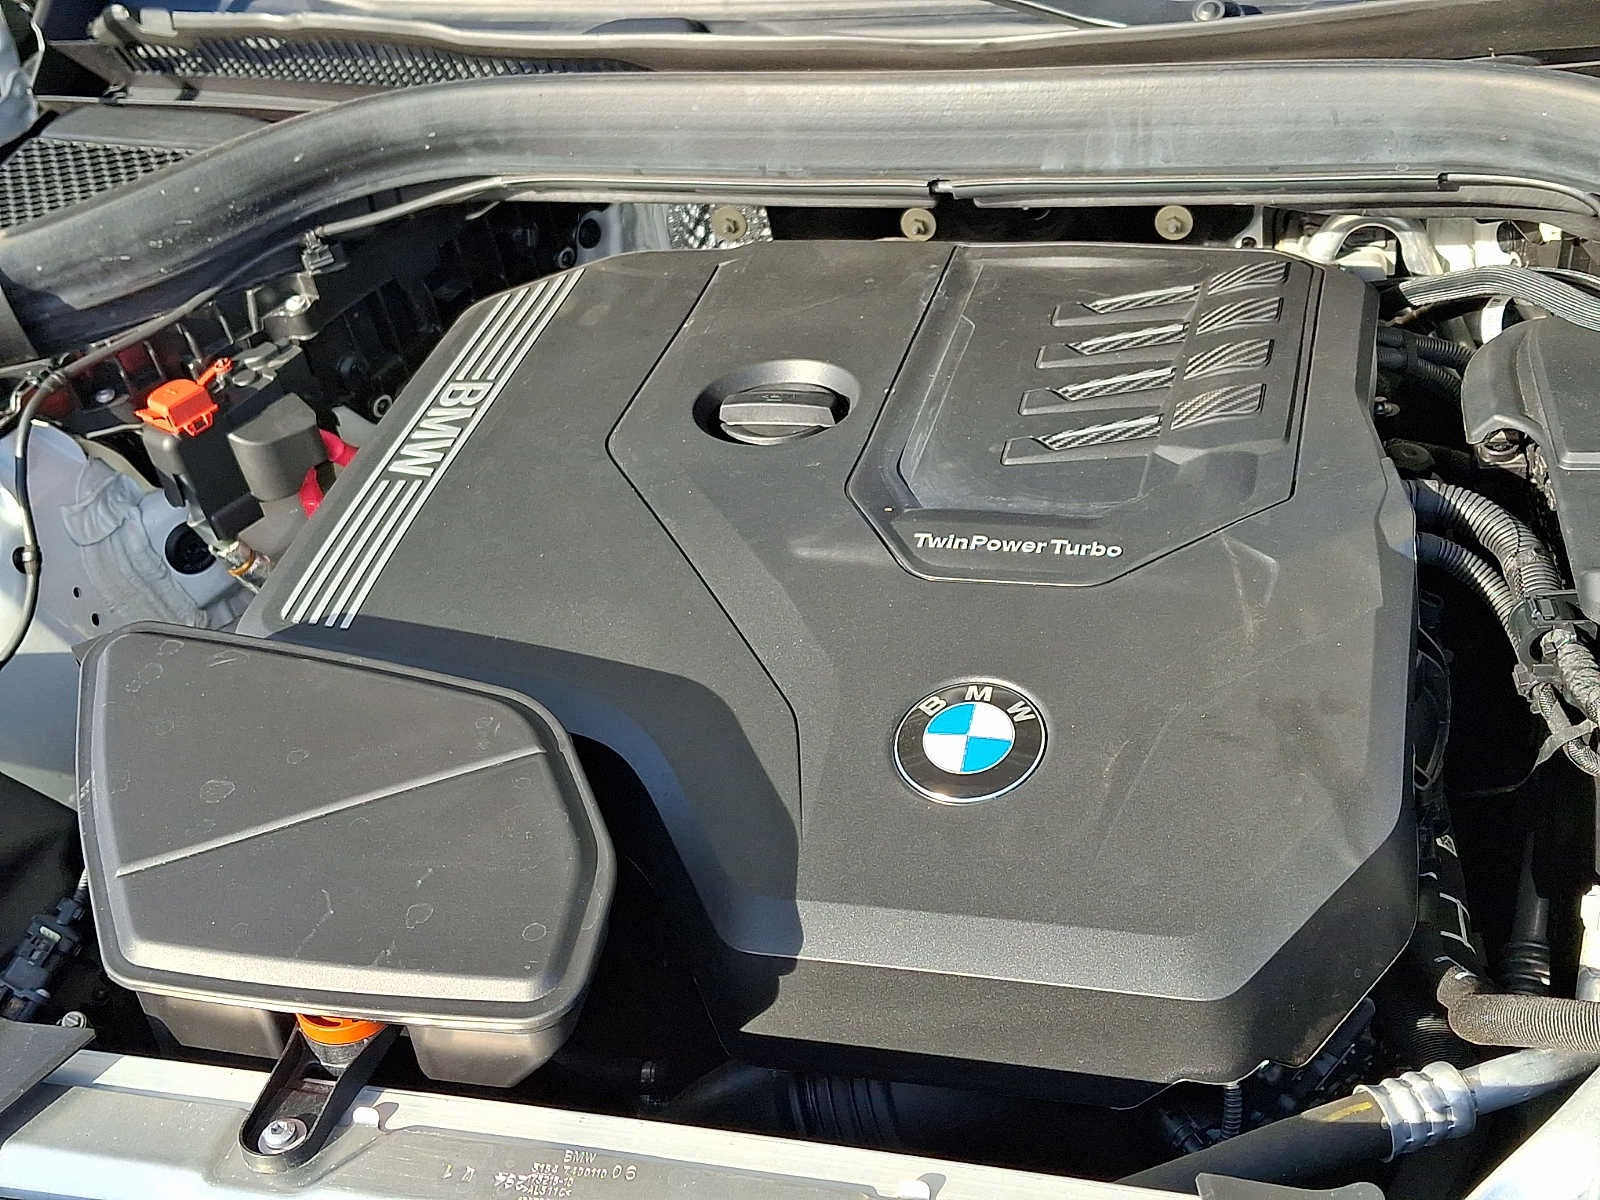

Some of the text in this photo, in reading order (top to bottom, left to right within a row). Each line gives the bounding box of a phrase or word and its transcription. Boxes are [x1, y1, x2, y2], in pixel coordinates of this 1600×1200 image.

[388, 381, 498, 478] BMW
[913, 532, 1123, 557] TwinPower Turbo
[918, 685, 1036, 723] BMW
[563, 1149, 597, 1163] BMW
